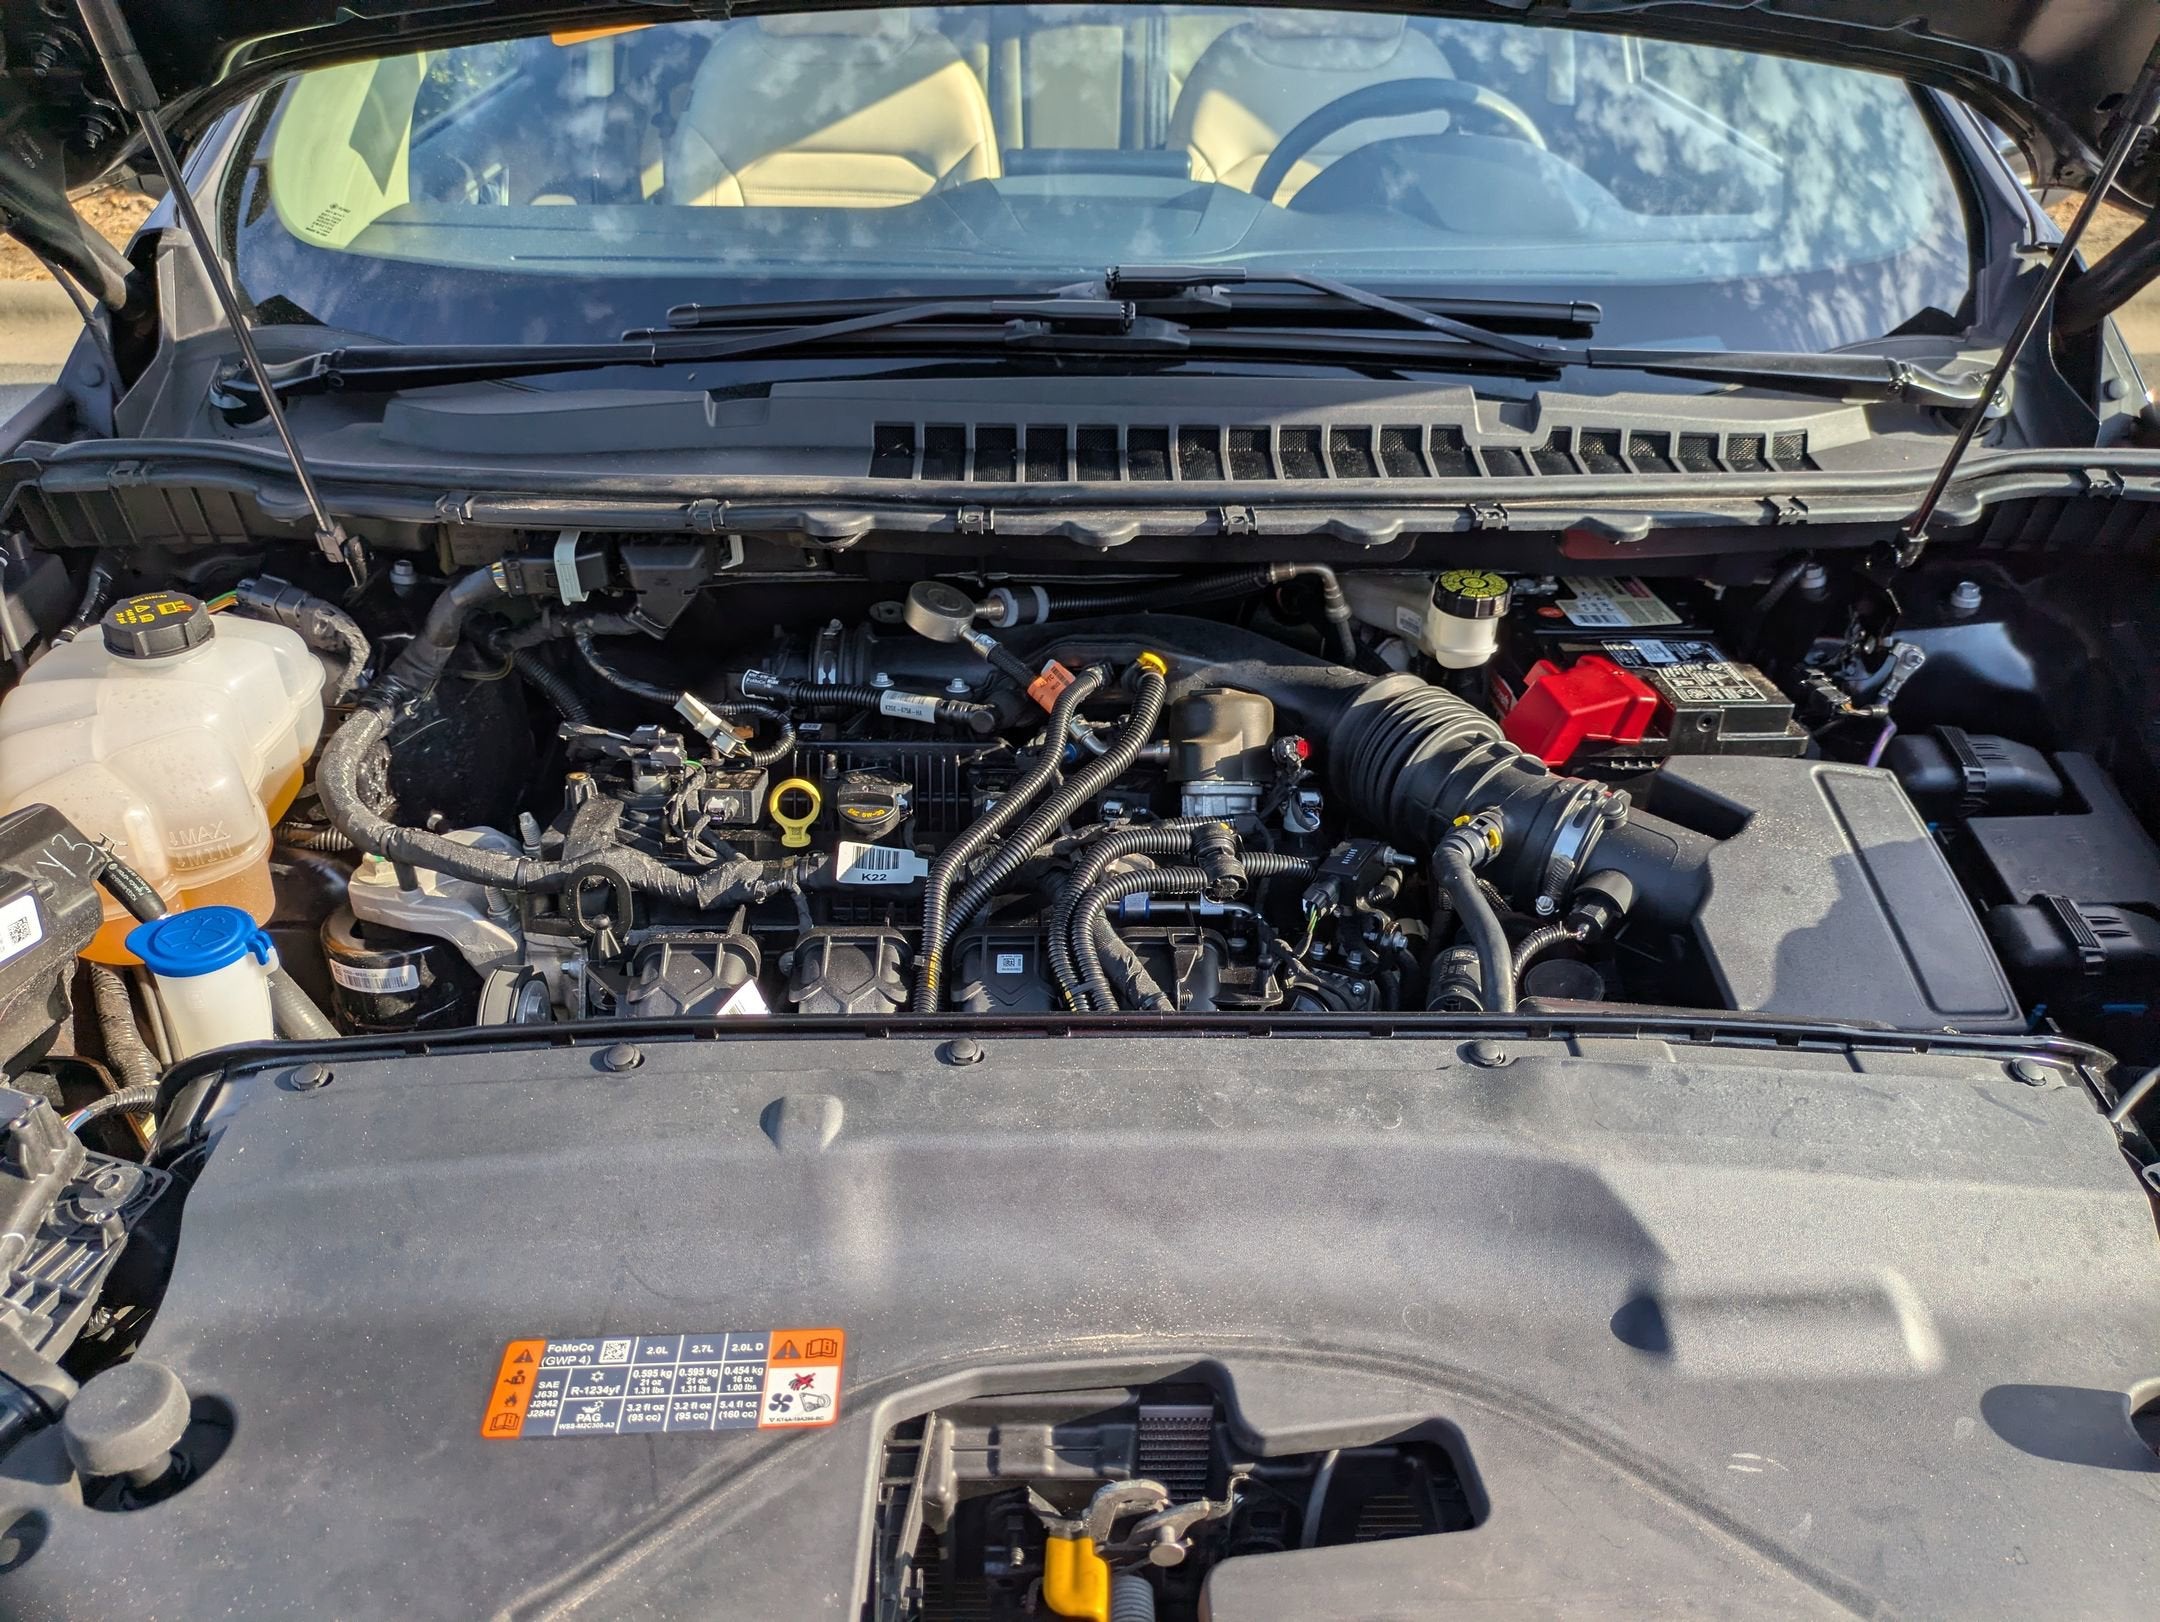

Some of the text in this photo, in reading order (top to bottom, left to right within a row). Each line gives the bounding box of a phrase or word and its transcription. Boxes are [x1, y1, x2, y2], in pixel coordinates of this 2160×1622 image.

[179, 820, 227, 845] MAX
[186, 842, 233, 867] MIN
[861, 873, 887, 881] K22
[547, 1343, 595, 1354] FoMoCo
[645, 1346, 669, 1355] 2.0L
[691, 1344, 714, 1353] 2.7L
[731, 1342, 764, 1352] 2.0L D
[541, 1355, 592, 1367] (GWP 4)
[632, 1369, 673, 1380] 0.595 kg
[678, 1367, 719, 1378] 0.595 kg
[724, 1366, 764, 1376] 0.454 kg
[538, 1381, 561, 1389] SAE
[640, 1378, 650, 1386] 21
[686, 1377, 695, 1385] 21
[570, 1385, 621, 1397] R-1234yf
[634, 1386, 665, 1394] 1.31 lbs
[680, 1385, 712, 1393] 1.31 lbs
[744, 1383, 757, 1391] lbs
[534, 1390, 559, 1399] J639
[530, 1399, 559, 1408] J2842
[626, 1403, 641, 1412] 3.2
[643, 1402, 651, 1411] fl
[673, 1401, 712, 1411] 3.2 fl oz
[720, 1400, 757, 1409] 5.4 fl oz
[527, 1409, 556, 1418] J2845
[576, 1413, 602, 1422] PAG
[627, 1412, 661, 1424] (95 cc)
[674, 1410, 709, 1422] (95 cc)
[718, 1409, 758, 1421] (160 cc)
